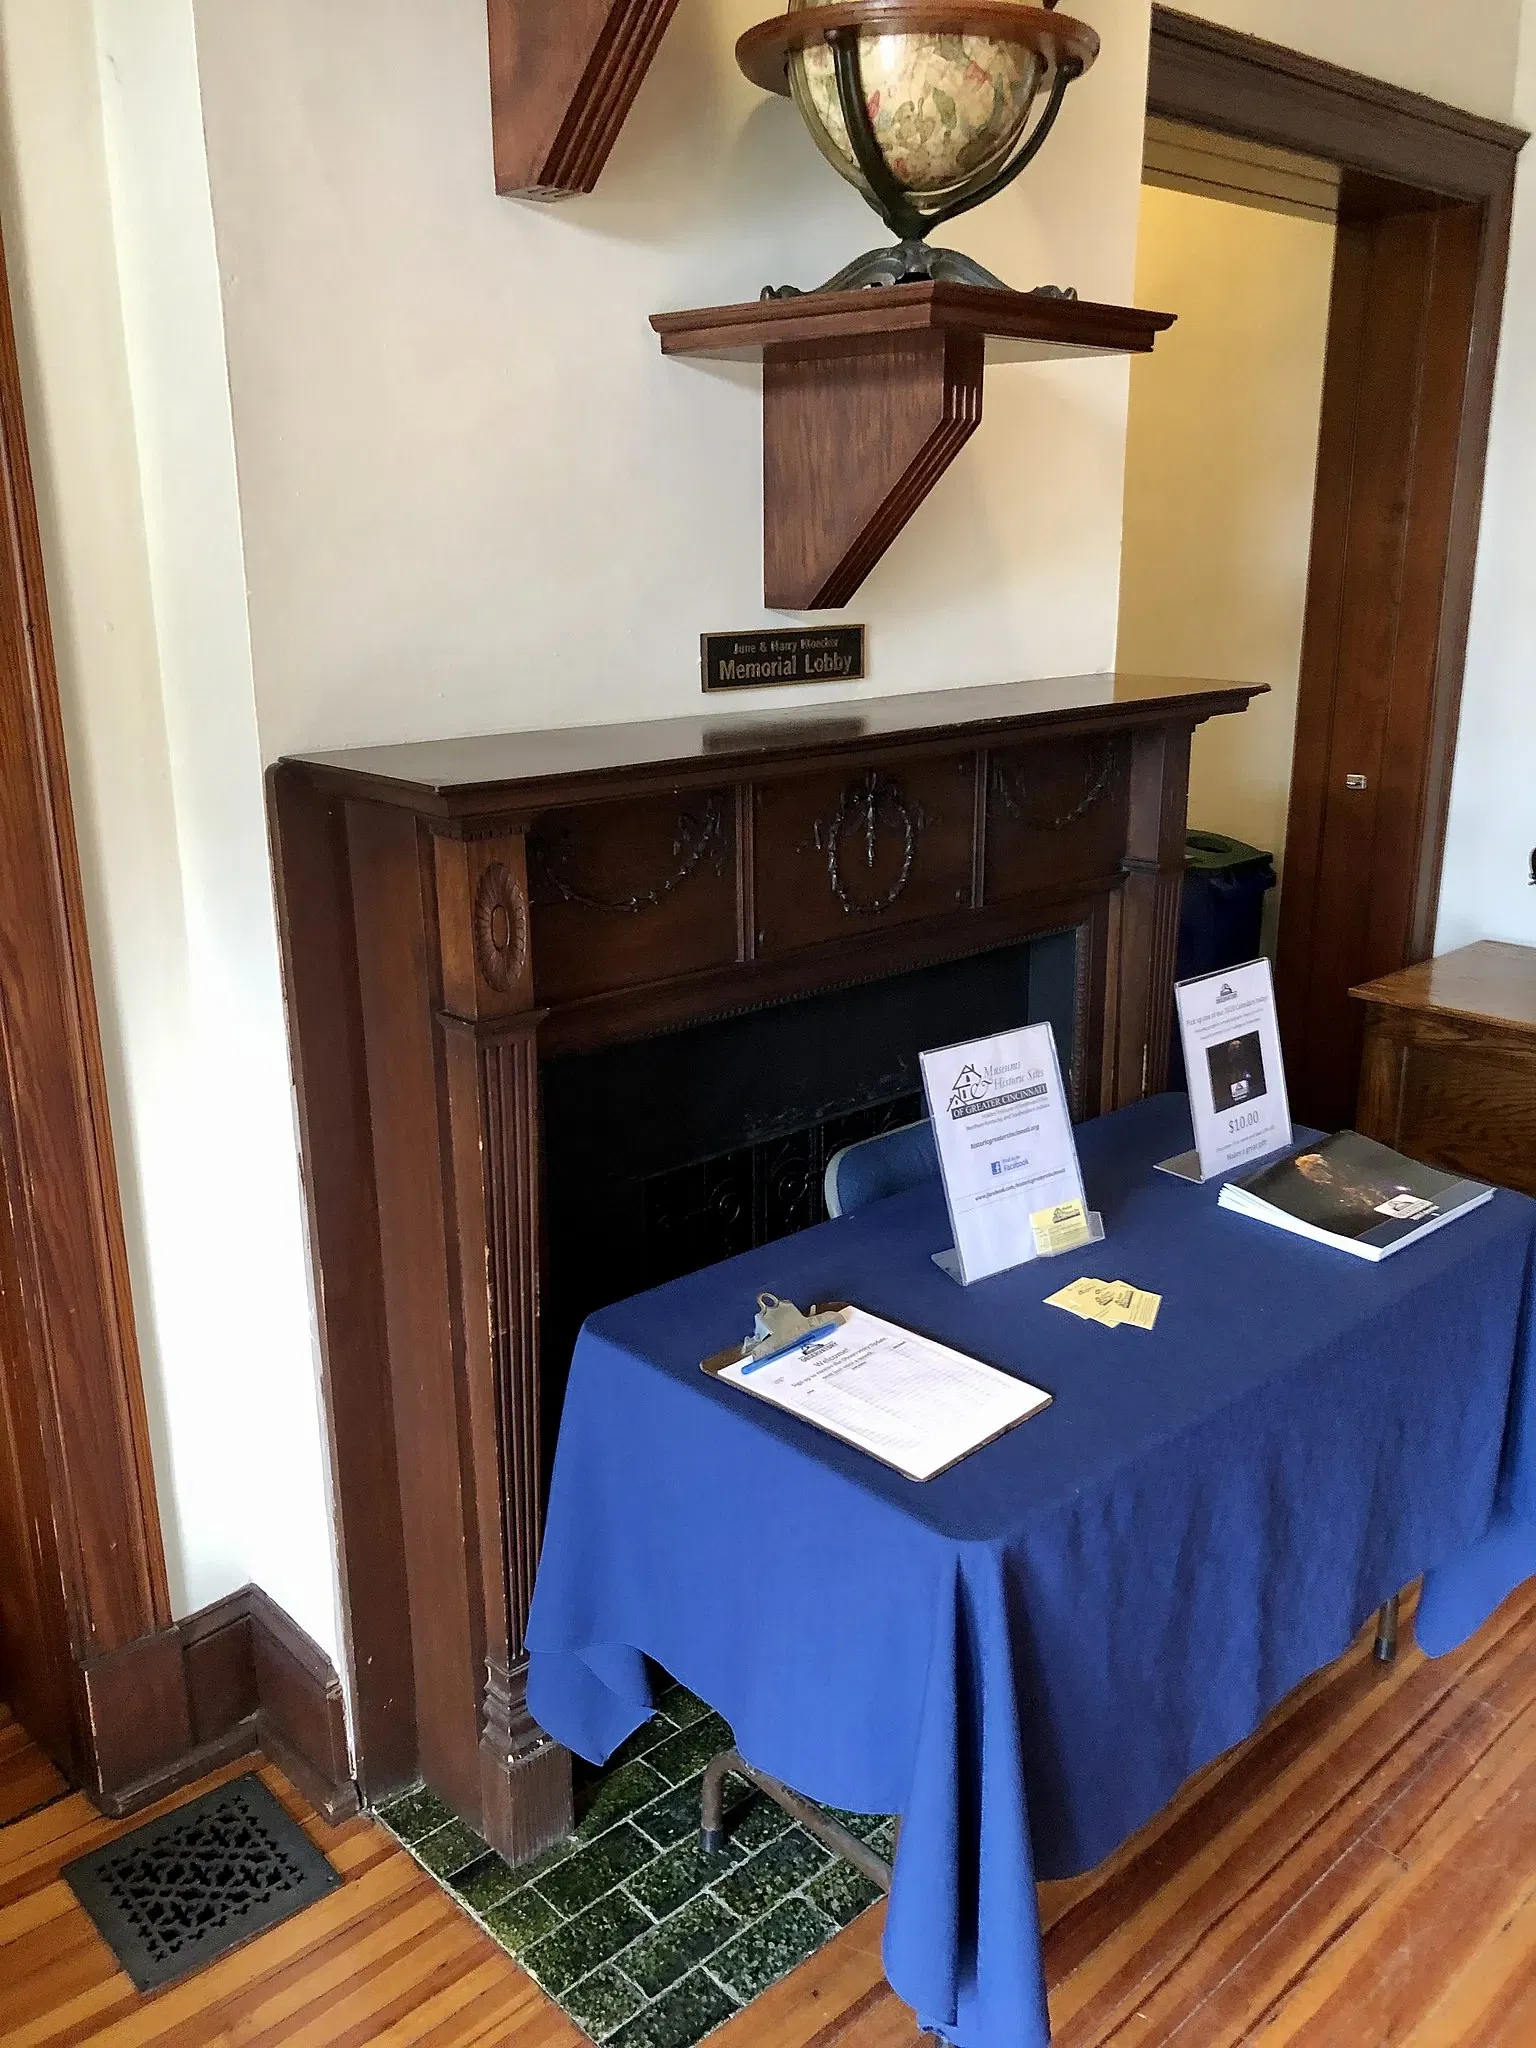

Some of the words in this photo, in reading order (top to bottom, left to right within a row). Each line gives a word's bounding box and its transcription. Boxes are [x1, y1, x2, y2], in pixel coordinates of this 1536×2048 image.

[734, 642, 757, 655] June
[759, 641, 768, 653] &
[771, 640, 798, 653] Harry
[719, 655, 797, 681] Memorial
[804, 651, 852, 675] Lobby
[984, 1061, 1021, 1078] Museums
[994, 1074, 1025, 1091] Historic
[1026, 1069, 1045, 1081] Sites
[953, 1107, 965, 1118] OF
[965, 1097, 1001, 1115] GREATER
[1001, 1084, 1047, 1104] CINCINNATI
[1228, 1110, 1259, 1134] $10.00
[1003, 1158, 1029, 1172] Facebook
